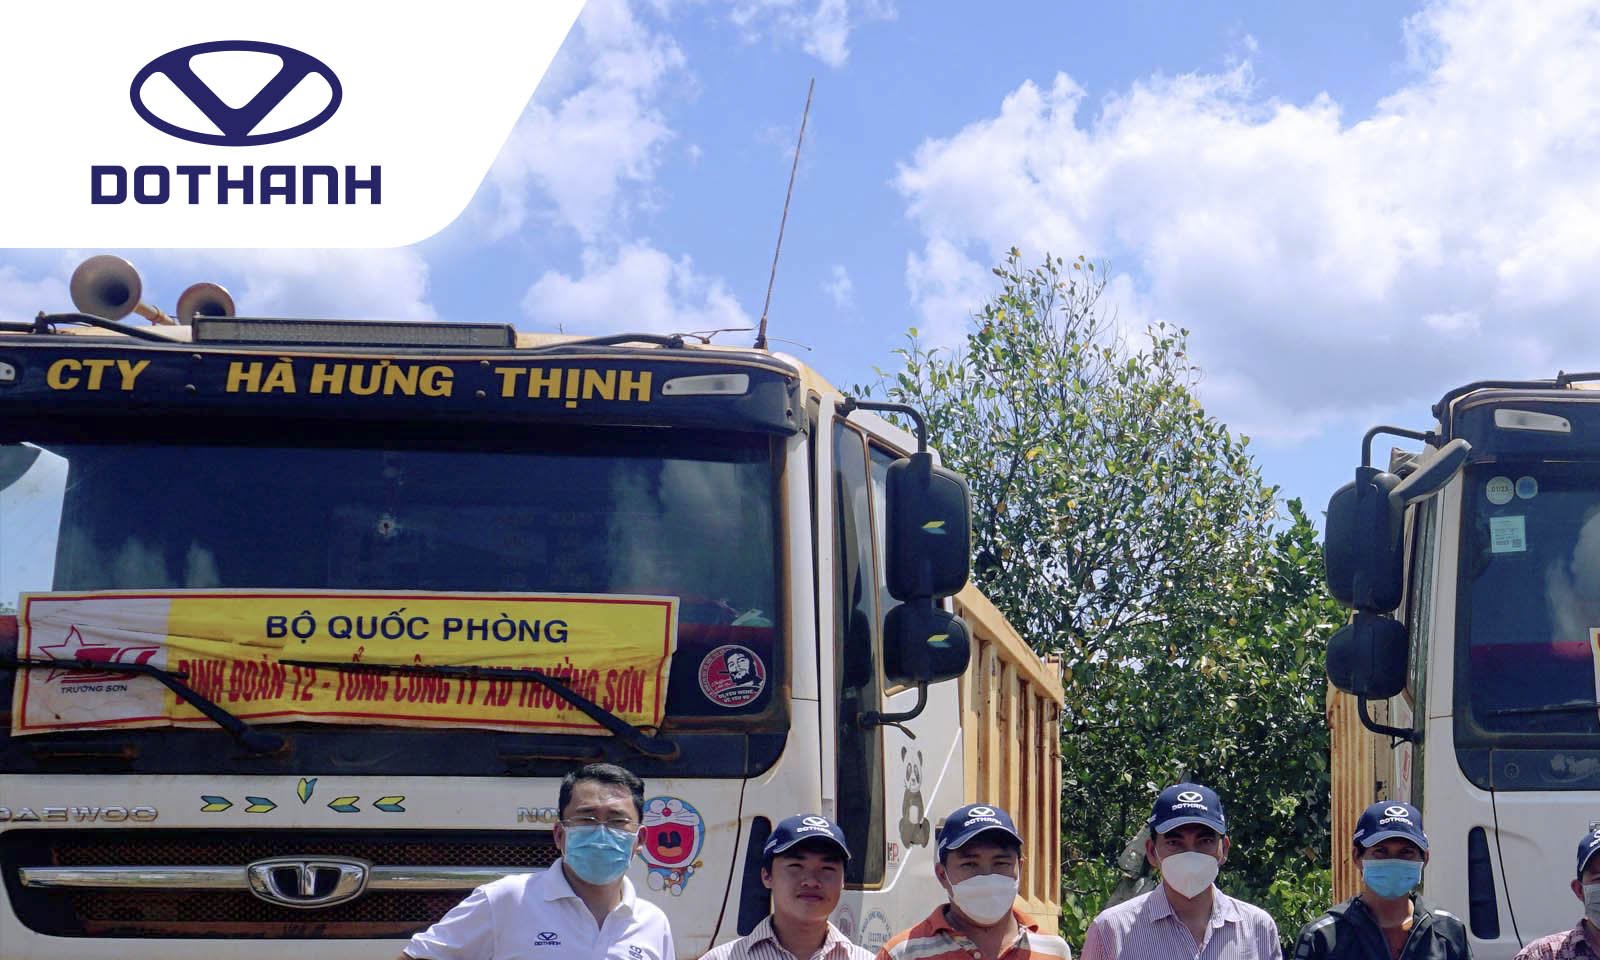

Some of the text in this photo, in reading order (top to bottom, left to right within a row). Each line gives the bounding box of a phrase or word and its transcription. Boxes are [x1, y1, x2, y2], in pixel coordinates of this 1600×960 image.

[46, 356, 652, 409] CTY HÀ HƯNG THỊNH
[266, 606, 570, 645] BỘ QUỐC PHÒNG
